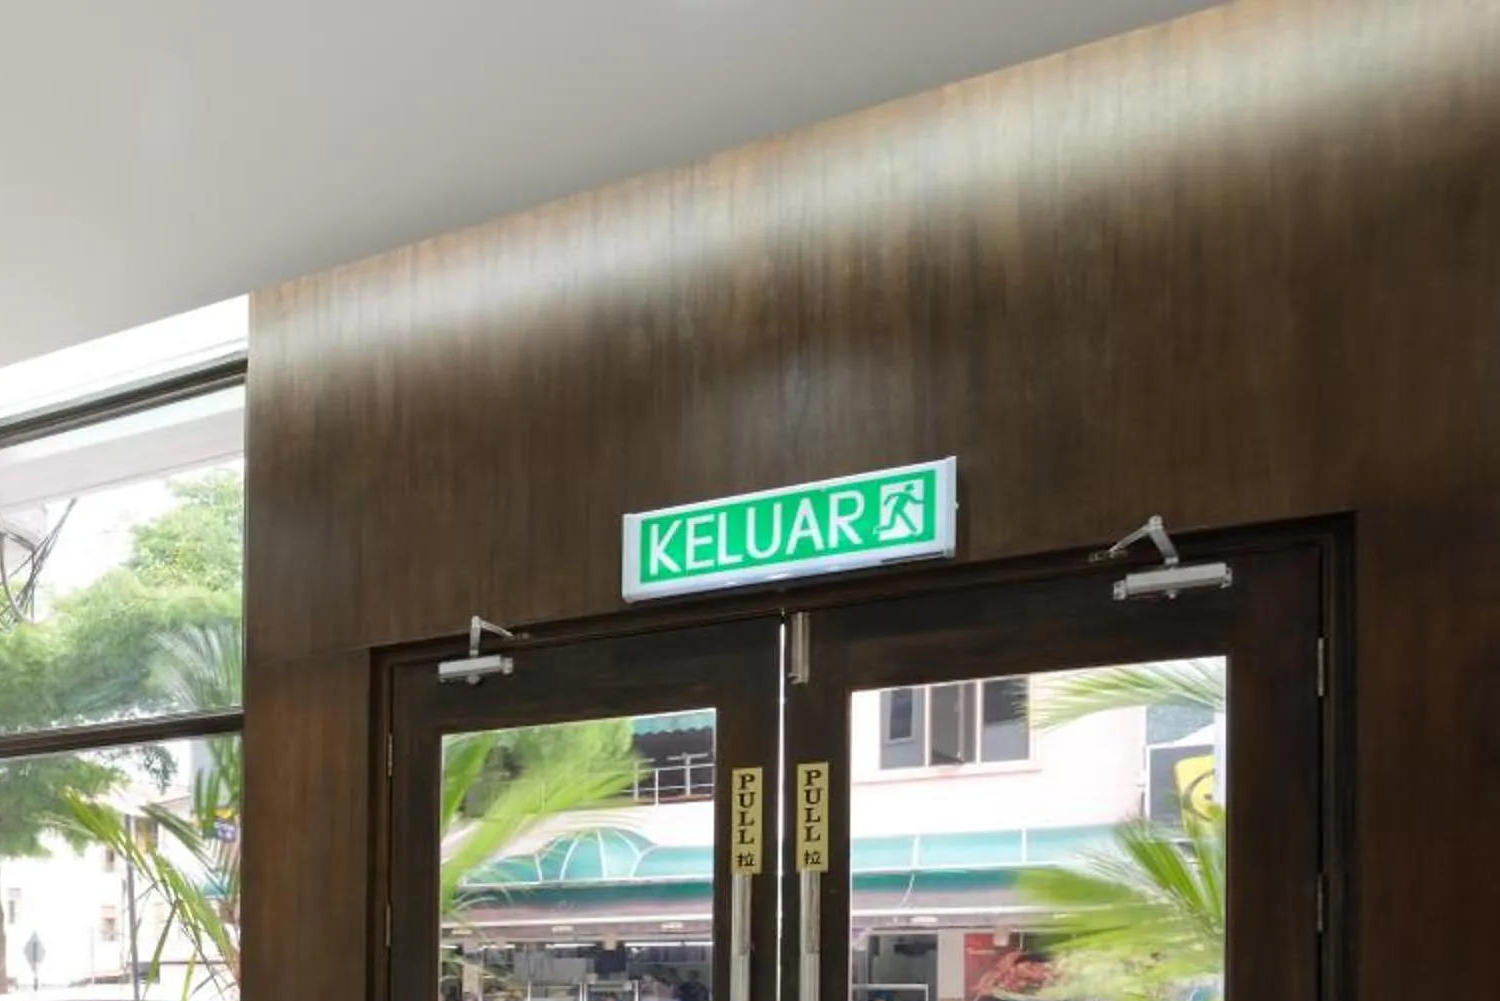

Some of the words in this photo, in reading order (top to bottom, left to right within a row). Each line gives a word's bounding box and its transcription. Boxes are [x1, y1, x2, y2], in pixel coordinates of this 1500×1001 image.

[648, 491, 865, 576] KELUAR
[736, 773, 756, 845] PULL
[803, 769, 822, 843] PULL
[736, 851, 755, 868] 拉
[803, 849, 822, 866] 拉
